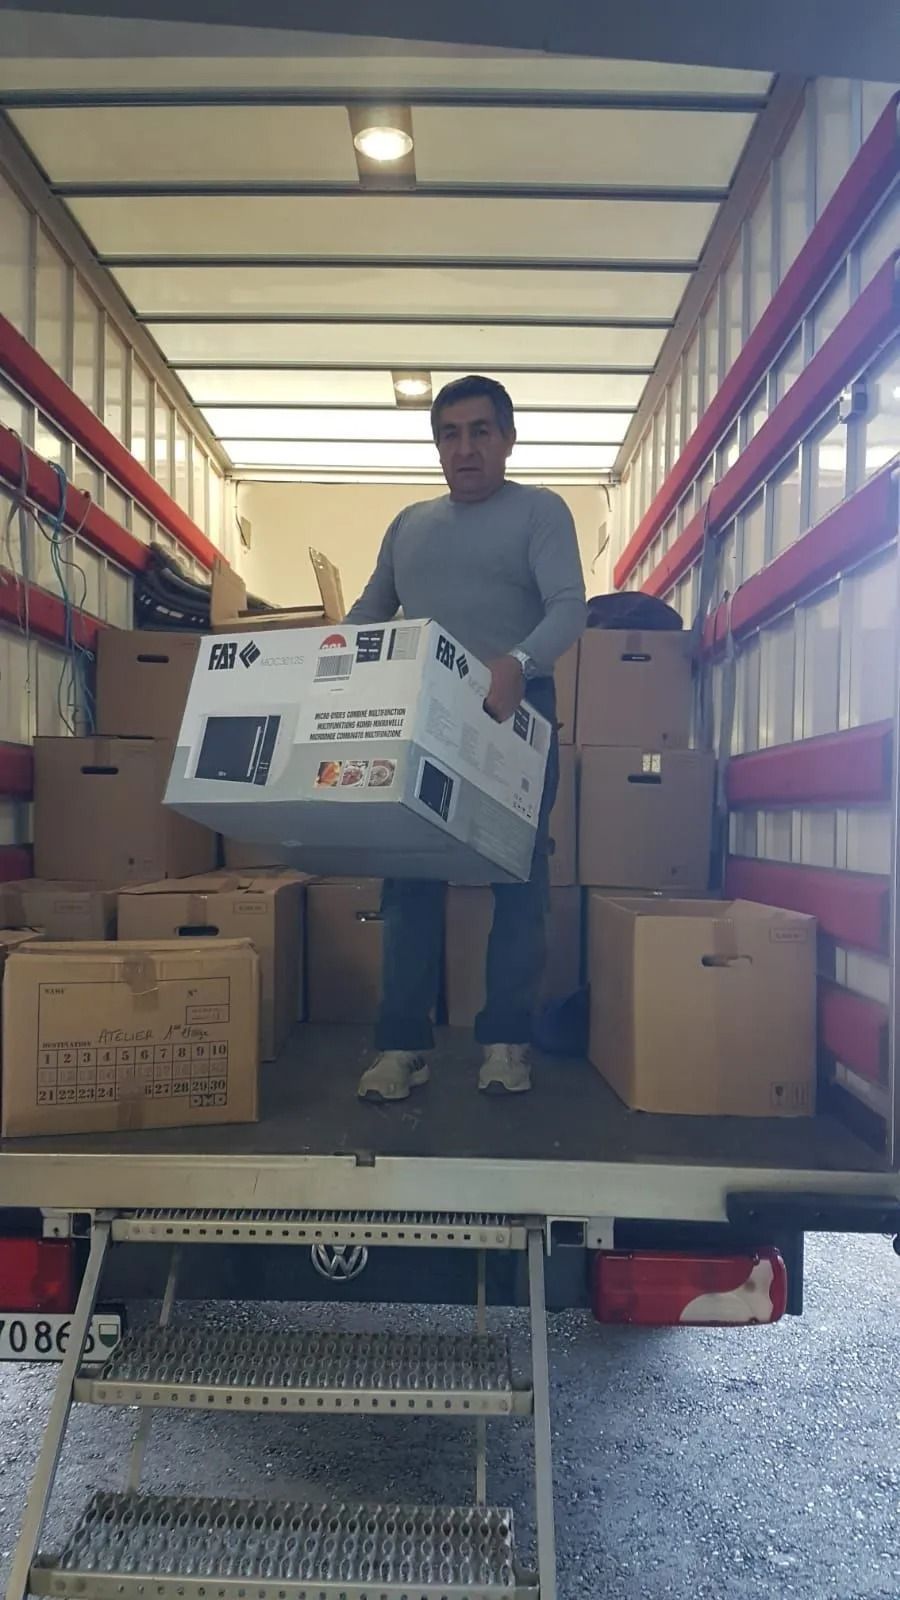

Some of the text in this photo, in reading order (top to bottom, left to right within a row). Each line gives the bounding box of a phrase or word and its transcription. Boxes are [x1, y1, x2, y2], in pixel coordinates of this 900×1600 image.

[208, 642, 238, 671] FAR
[99, 1028, 152, 1044] ATELIER
[45, 1044, 226, 1064] 1 2 3 4 5 6 7 8 9 10
[39, 1090, 54, 1102] 21
[59, 1089, 75, 1100] 22
[78, 1087, 95, 1099] 23
[97, 1087, 113, 1098] 24
[154, 1083, 170, 1094] 27
[173, 1082, 190, 1093] 28
[192, 1081, 208, 1092] 29
[210, 1080, 226, 1091] 30
